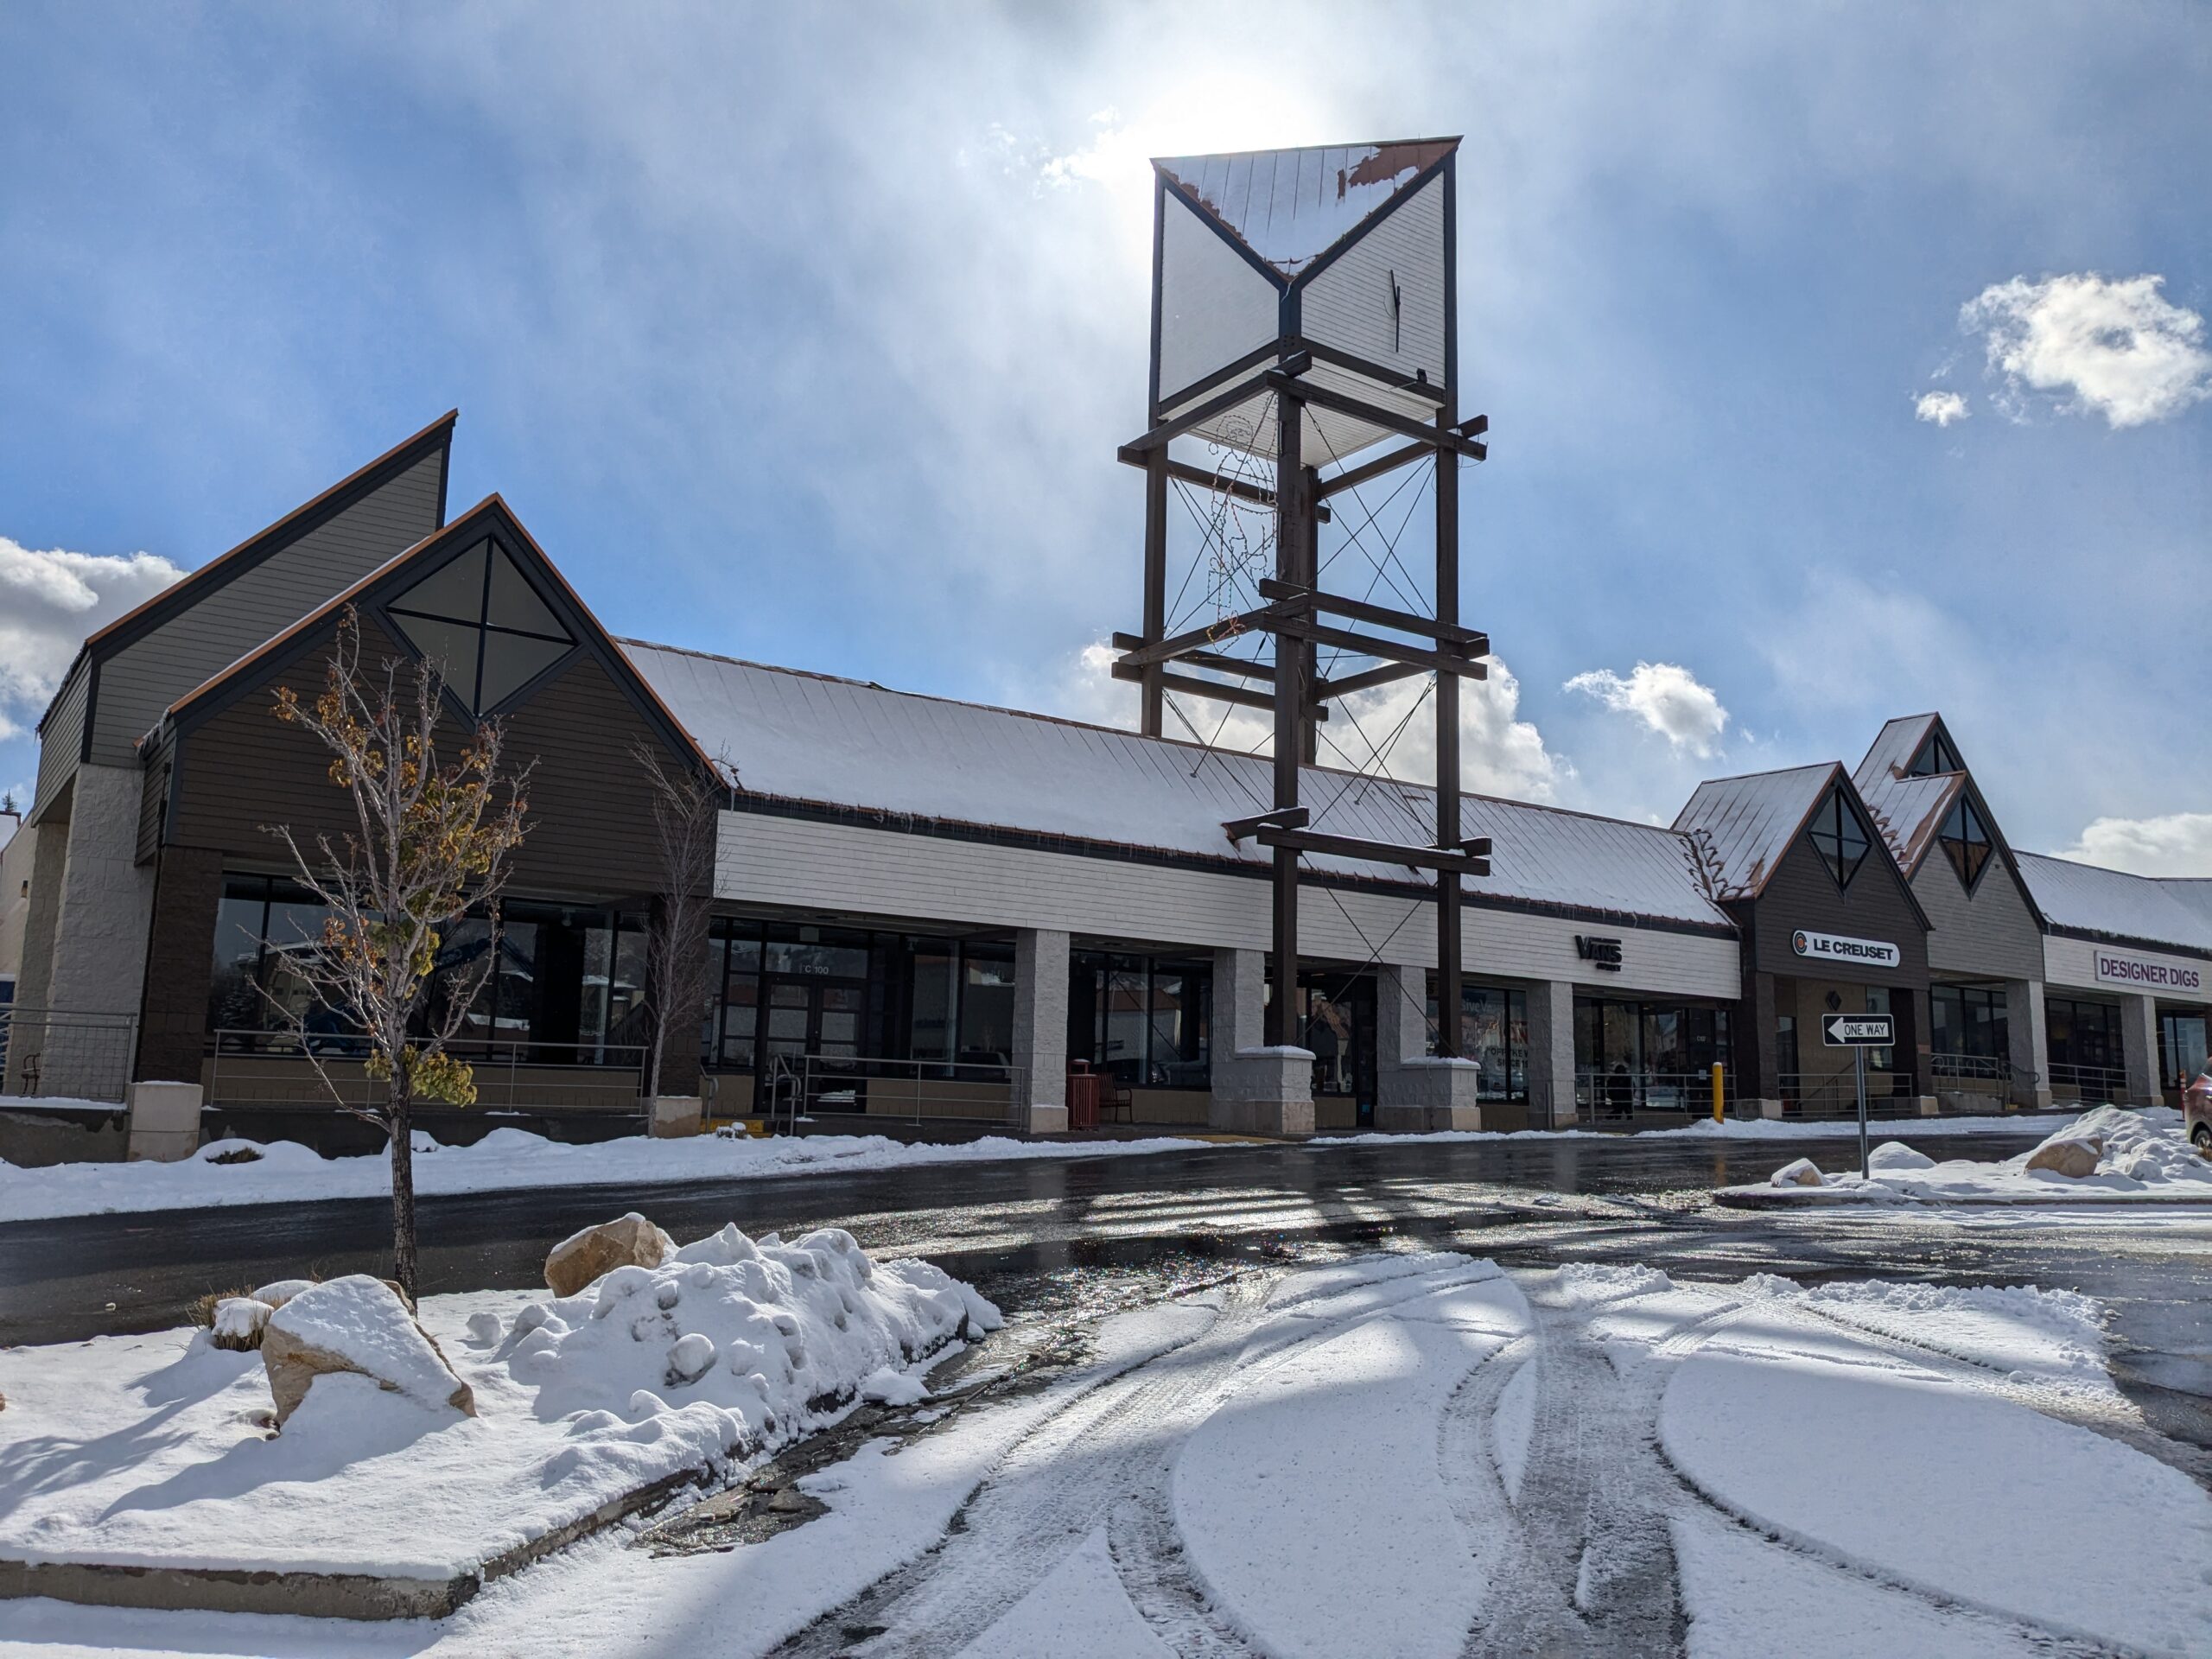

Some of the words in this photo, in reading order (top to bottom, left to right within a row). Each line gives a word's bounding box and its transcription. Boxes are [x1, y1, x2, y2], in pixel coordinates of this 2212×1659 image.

[1574, 935, 1622, 963] VANS
[1813, 938, 1831, 953] LE
[1833, 941, 1893, 961] CREUSET
[804, 964, 812, 973] C
[815, 966, 830, 975] 100
[2101, 957, 2168, 984] DESIGNER
[2170, 968, 2199, 988] DIGS
[1844, 1024, 1864, 1036] ONE
[1866, 1024, 1885, 1035] WAY
[1497, 1058, 1521, 1067] SICE
